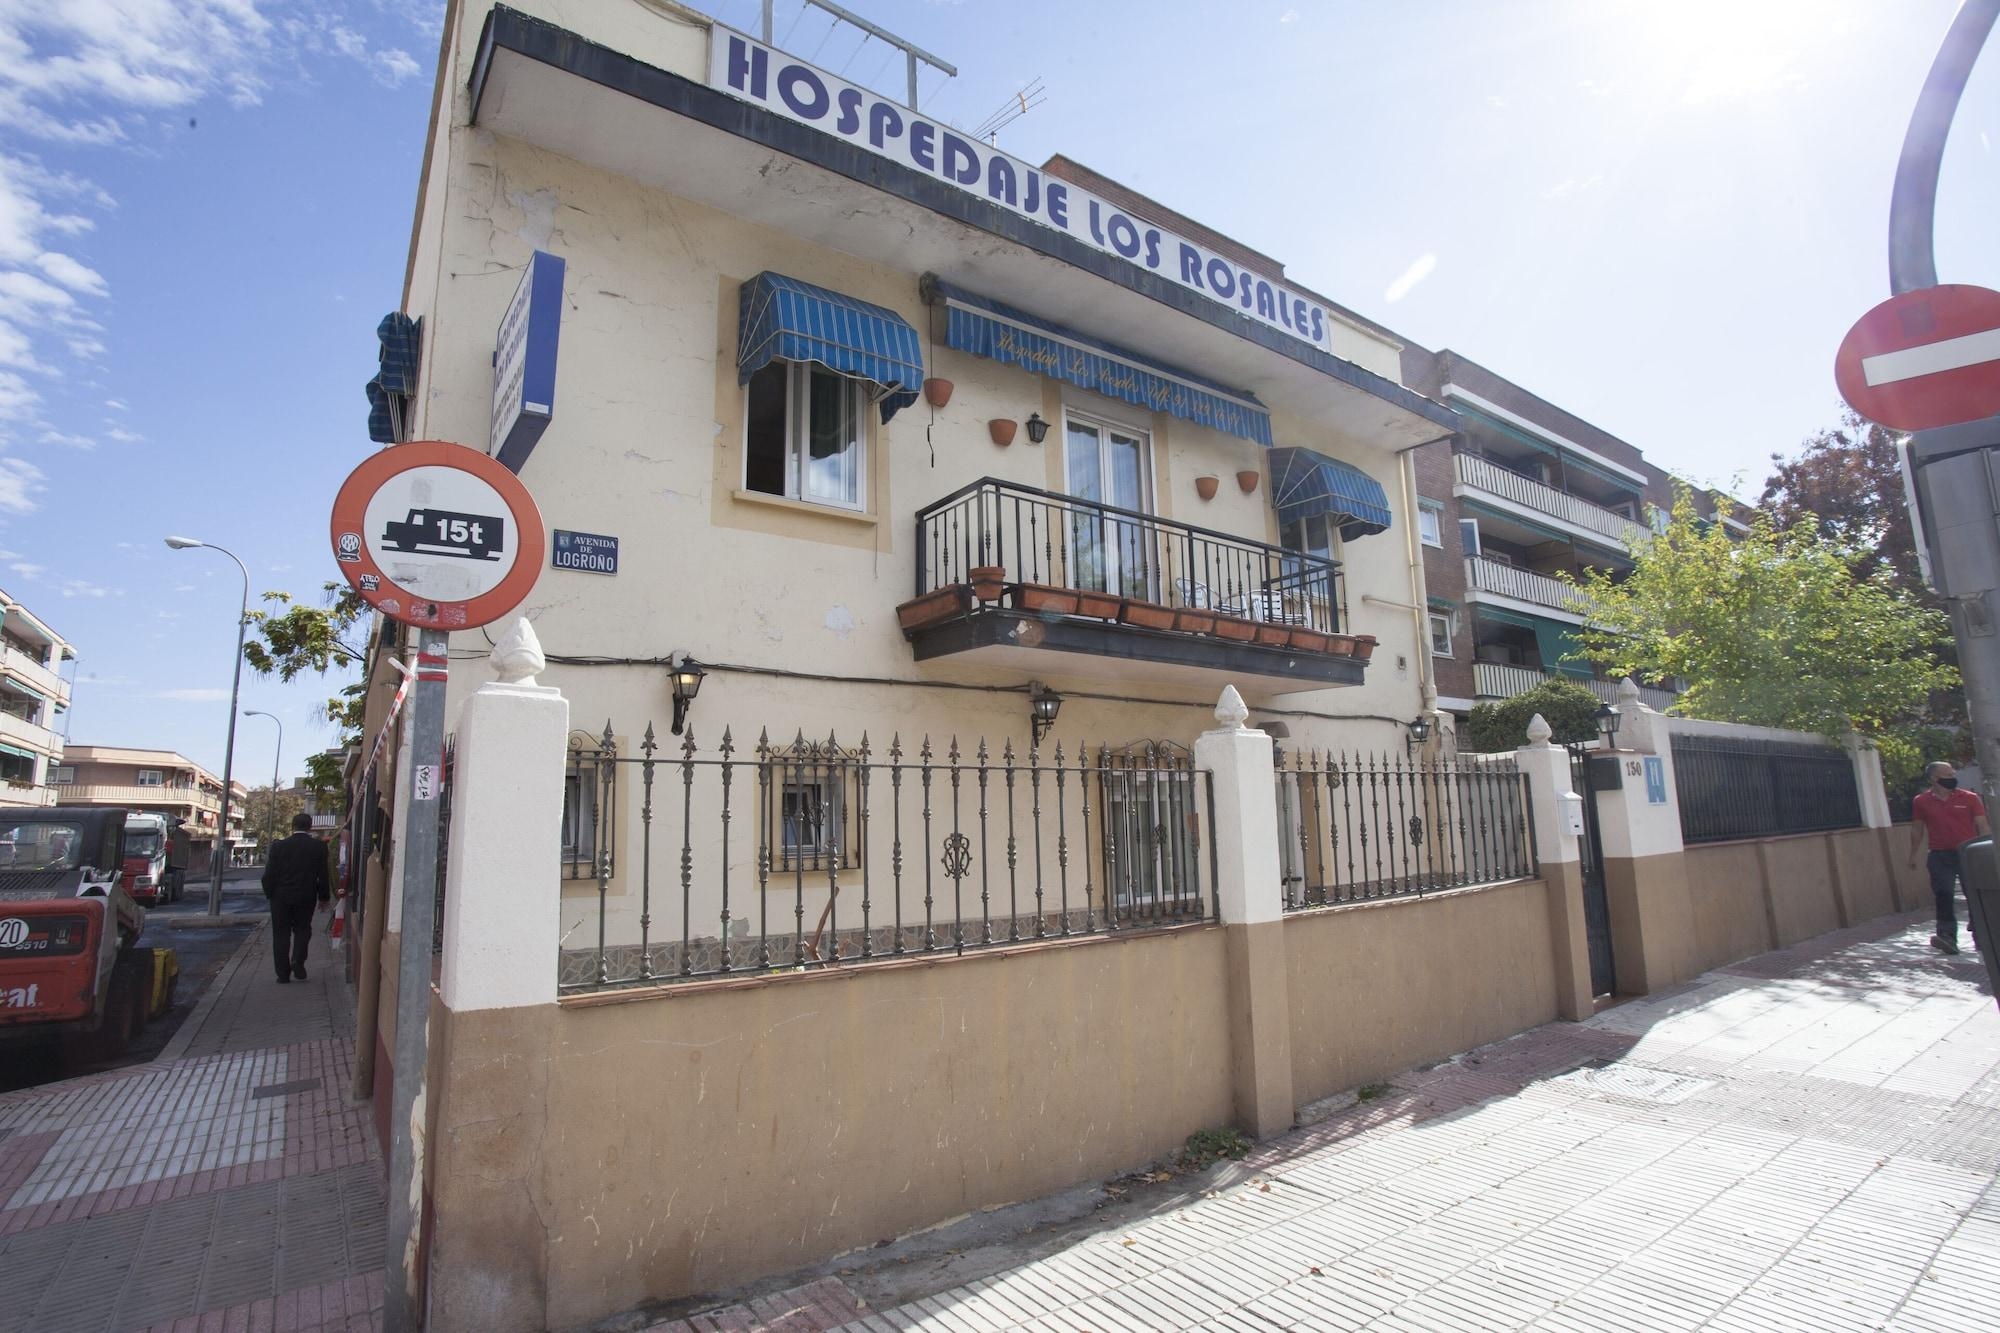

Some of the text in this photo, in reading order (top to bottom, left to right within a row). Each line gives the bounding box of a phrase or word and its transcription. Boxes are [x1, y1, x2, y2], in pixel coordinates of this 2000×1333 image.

[727, 35, 1324, 342] HOSPEDAJE LOS ROSALES
[437, 518, 484, 545] 15t
[574, 536, 616, 549] AVENIDA
[580, 546, 593, 554] DE
[557, 551, 614, 571] LOGROÑO
[1626, 760, 1641, 776] 150
[0, 921, 21, 945] 20
